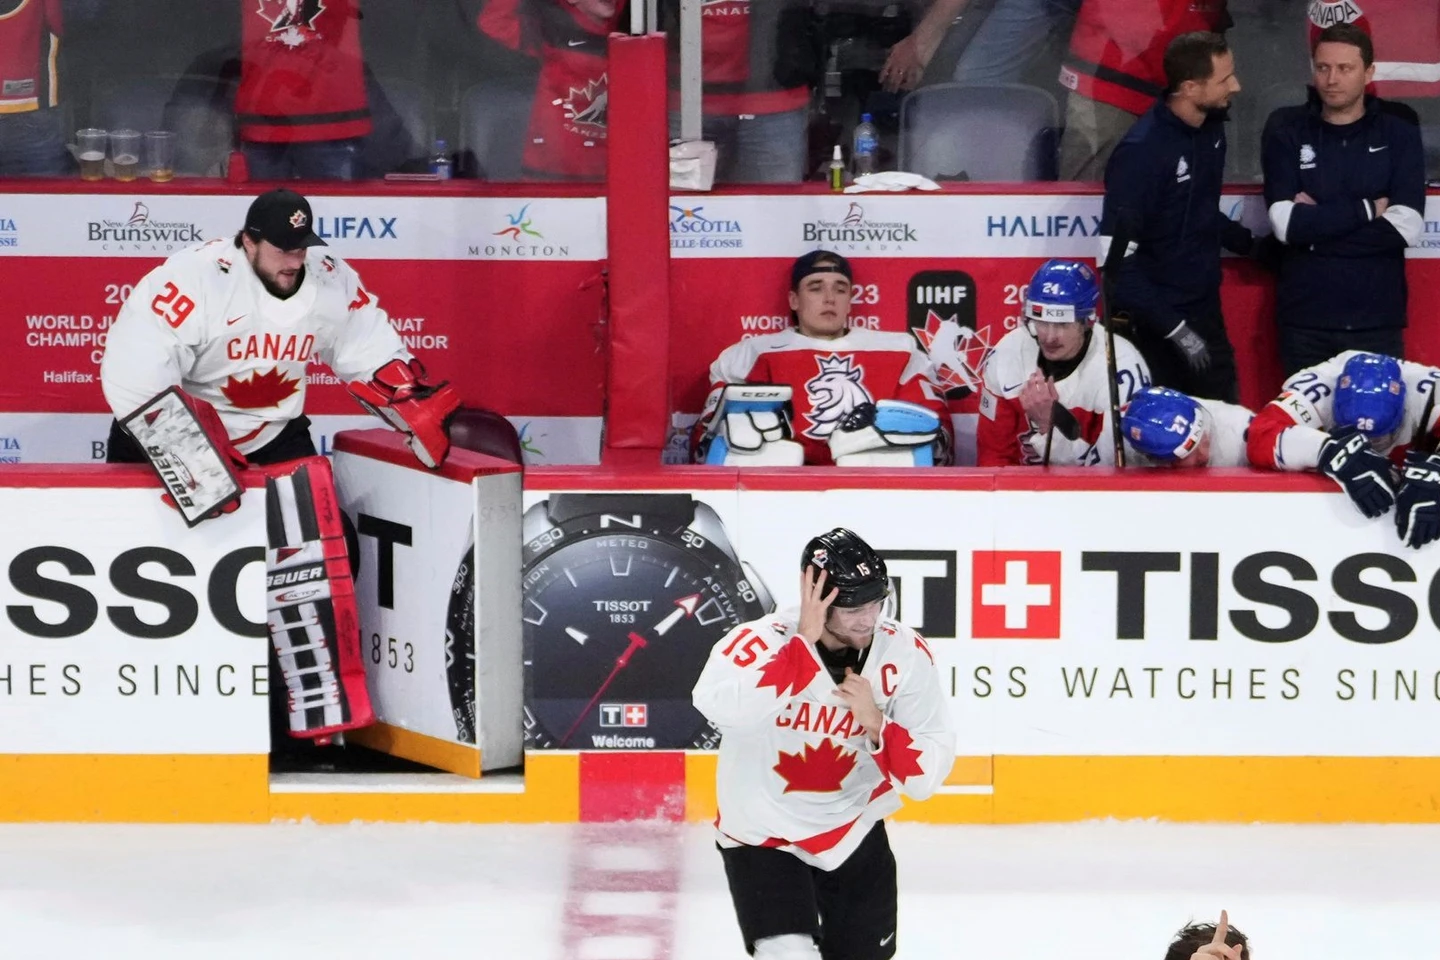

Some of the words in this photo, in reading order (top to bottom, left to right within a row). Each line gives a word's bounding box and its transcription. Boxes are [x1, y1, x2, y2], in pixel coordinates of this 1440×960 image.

[1309, 0, 1358, 25] ANADA
[88, 222, 204, 242] Brunswick
[103, 220, 123, 228] New
[318, 217, 398, 239] LIFAX
[682, 219, 742, 233] SCOTIA
[803, 222, 918, 242] Brunswick
[817, 220, 838, 228] New
[987, 215, 1102, 238] HALIFAX
[468, 245, 570, 257] MONCTON
[851, 284, 880, 305] 23
[916, 285, 968, 304] IIHF
[151, 281, 196, 329] 29
[1046, 308, 1065, 318] KB
[26, 315, 93, 330] WORLD
[741, 315, 790, 330] WORL
[227, 334, 315, 362] CANAD
[44, 371, 92, 384] Halifax
[304, 372, 342, 385] alifax
[1288, 372, 1332, 405] 26
[1289, 399, 1313, 425] KB
[1357, 417, 1375, 431] 26
[1329, 433, 1368, 472] CC
[147, 445, 194, 509] BAUER
[600, 514, 642, 529] N
[529, 526, 565, 553] 330
[680, 529, 706, 549] 30
[855, 561, 871, 577] 15
[592, 600, 652, 613] TISSOT
[702, 575, 741, 626] ACTIVIT
[609, 614, 636, 624] 1853
[721, 628, 769, 669] 15
[880, 663, 898, 698] C
[950, 665, 1028, 699] ISS
[1060, 665, 1302, 700] WATCHES
[592, 734, 656, 749] Welcome
